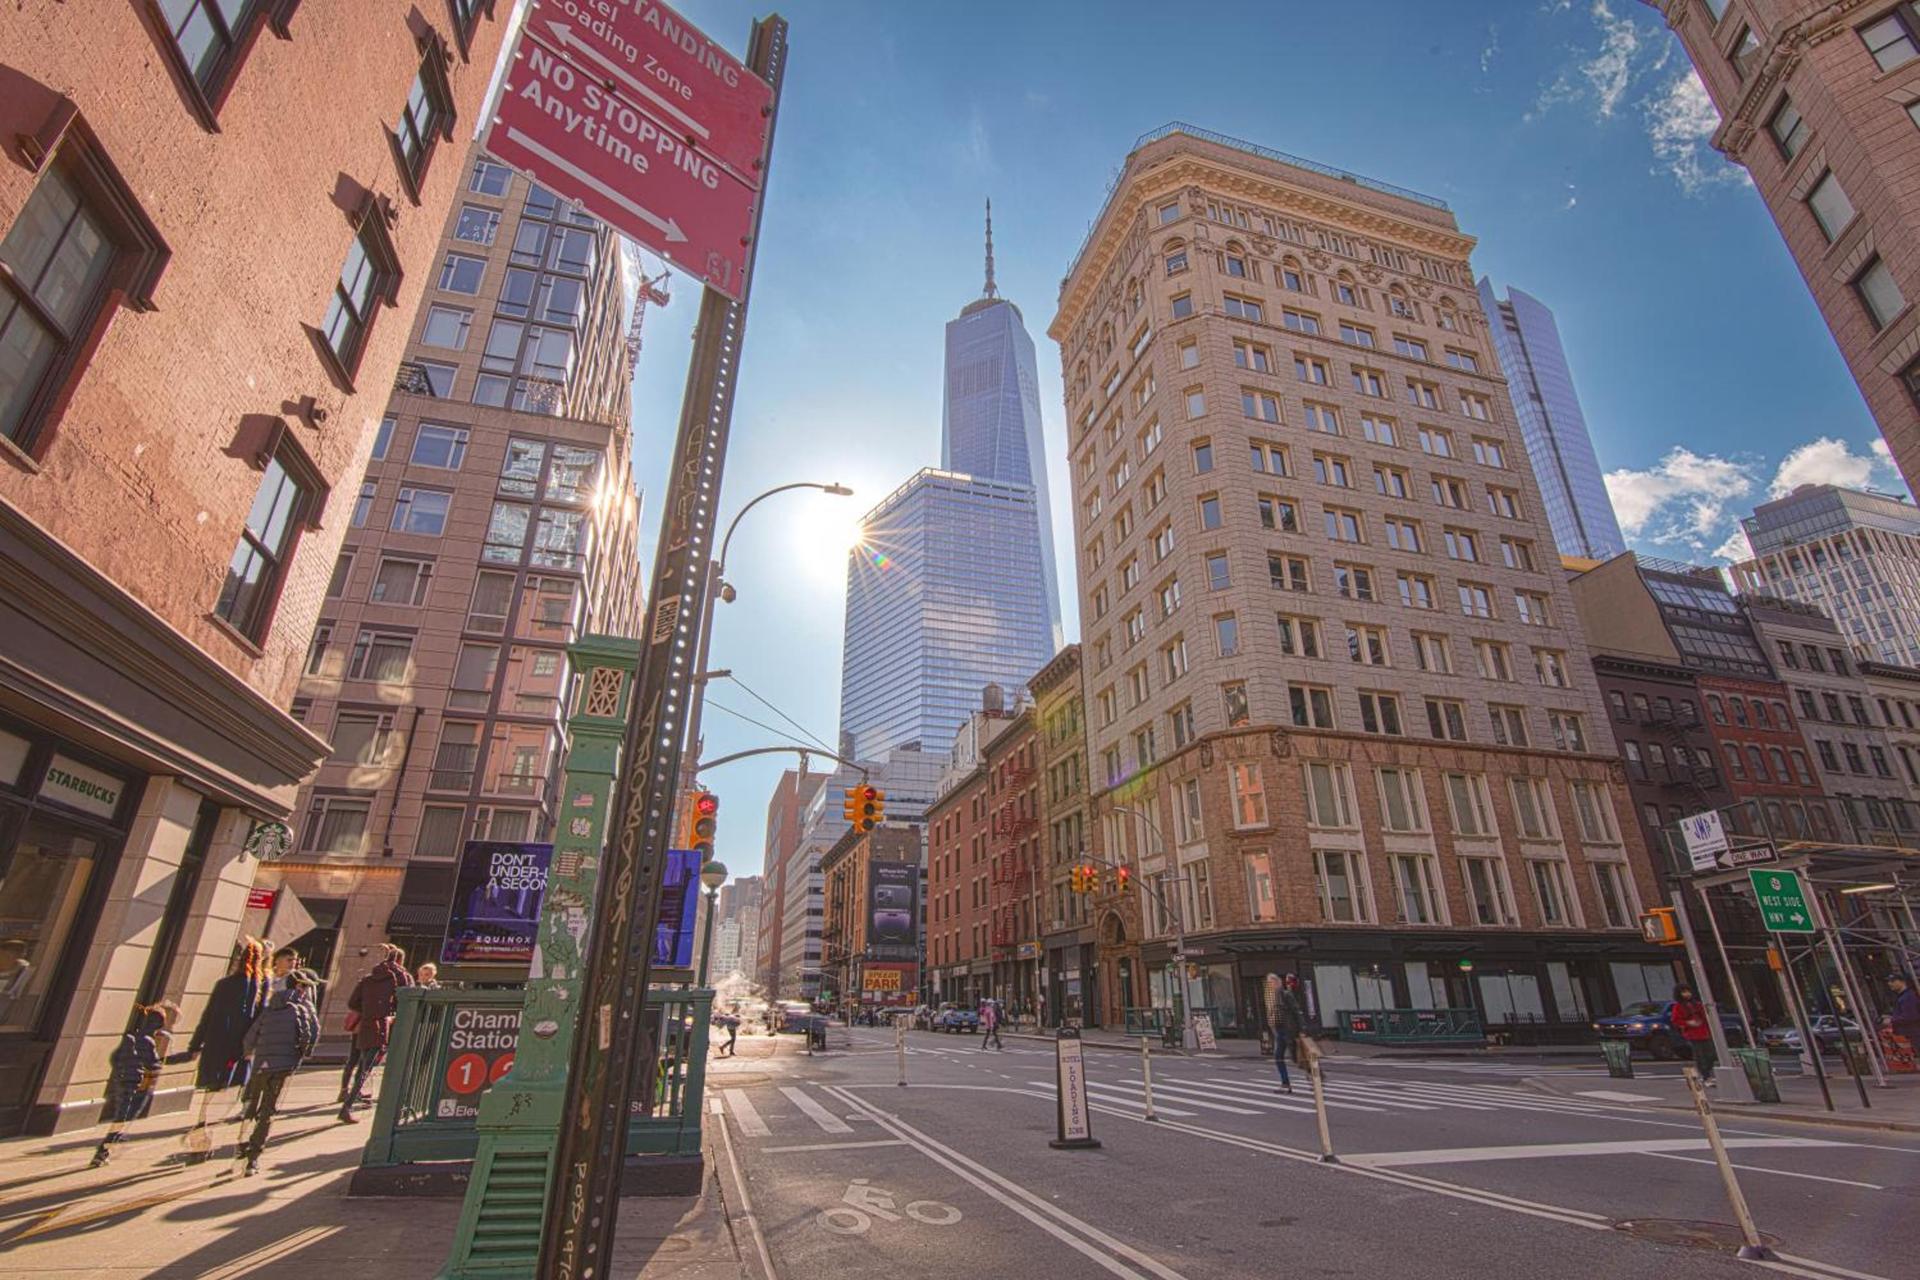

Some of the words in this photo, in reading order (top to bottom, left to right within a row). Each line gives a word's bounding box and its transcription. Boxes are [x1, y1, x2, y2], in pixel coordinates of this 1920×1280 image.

[620, 0, 739, 88] TANDING
[643, 54, 693, 100] Zone
[528, 47, 575, 91] NO
[581, 84, 720, 189] STOPPING
[520, 79, 650, 174] Anytime
[47, 767, 116, 805] STARBUCKS
[491, 853, 537, 866] DON'T
[1731, 852, 1748, 862] ONE
[1750, 848, 1768, 859] WAY
[486, 877, 498, 889] A
[1761, 895, 1782, 907] WEST
[1782, 896, 1802, 907] SIDE
[476, 935, 531, 944] EQUINOX
[865, 978, 899, 989] PARK
[455, 1010, 523, 1029] Cham
[461, 1062, 472, 1085] 1
[631, 1101, 643, 1112] St
